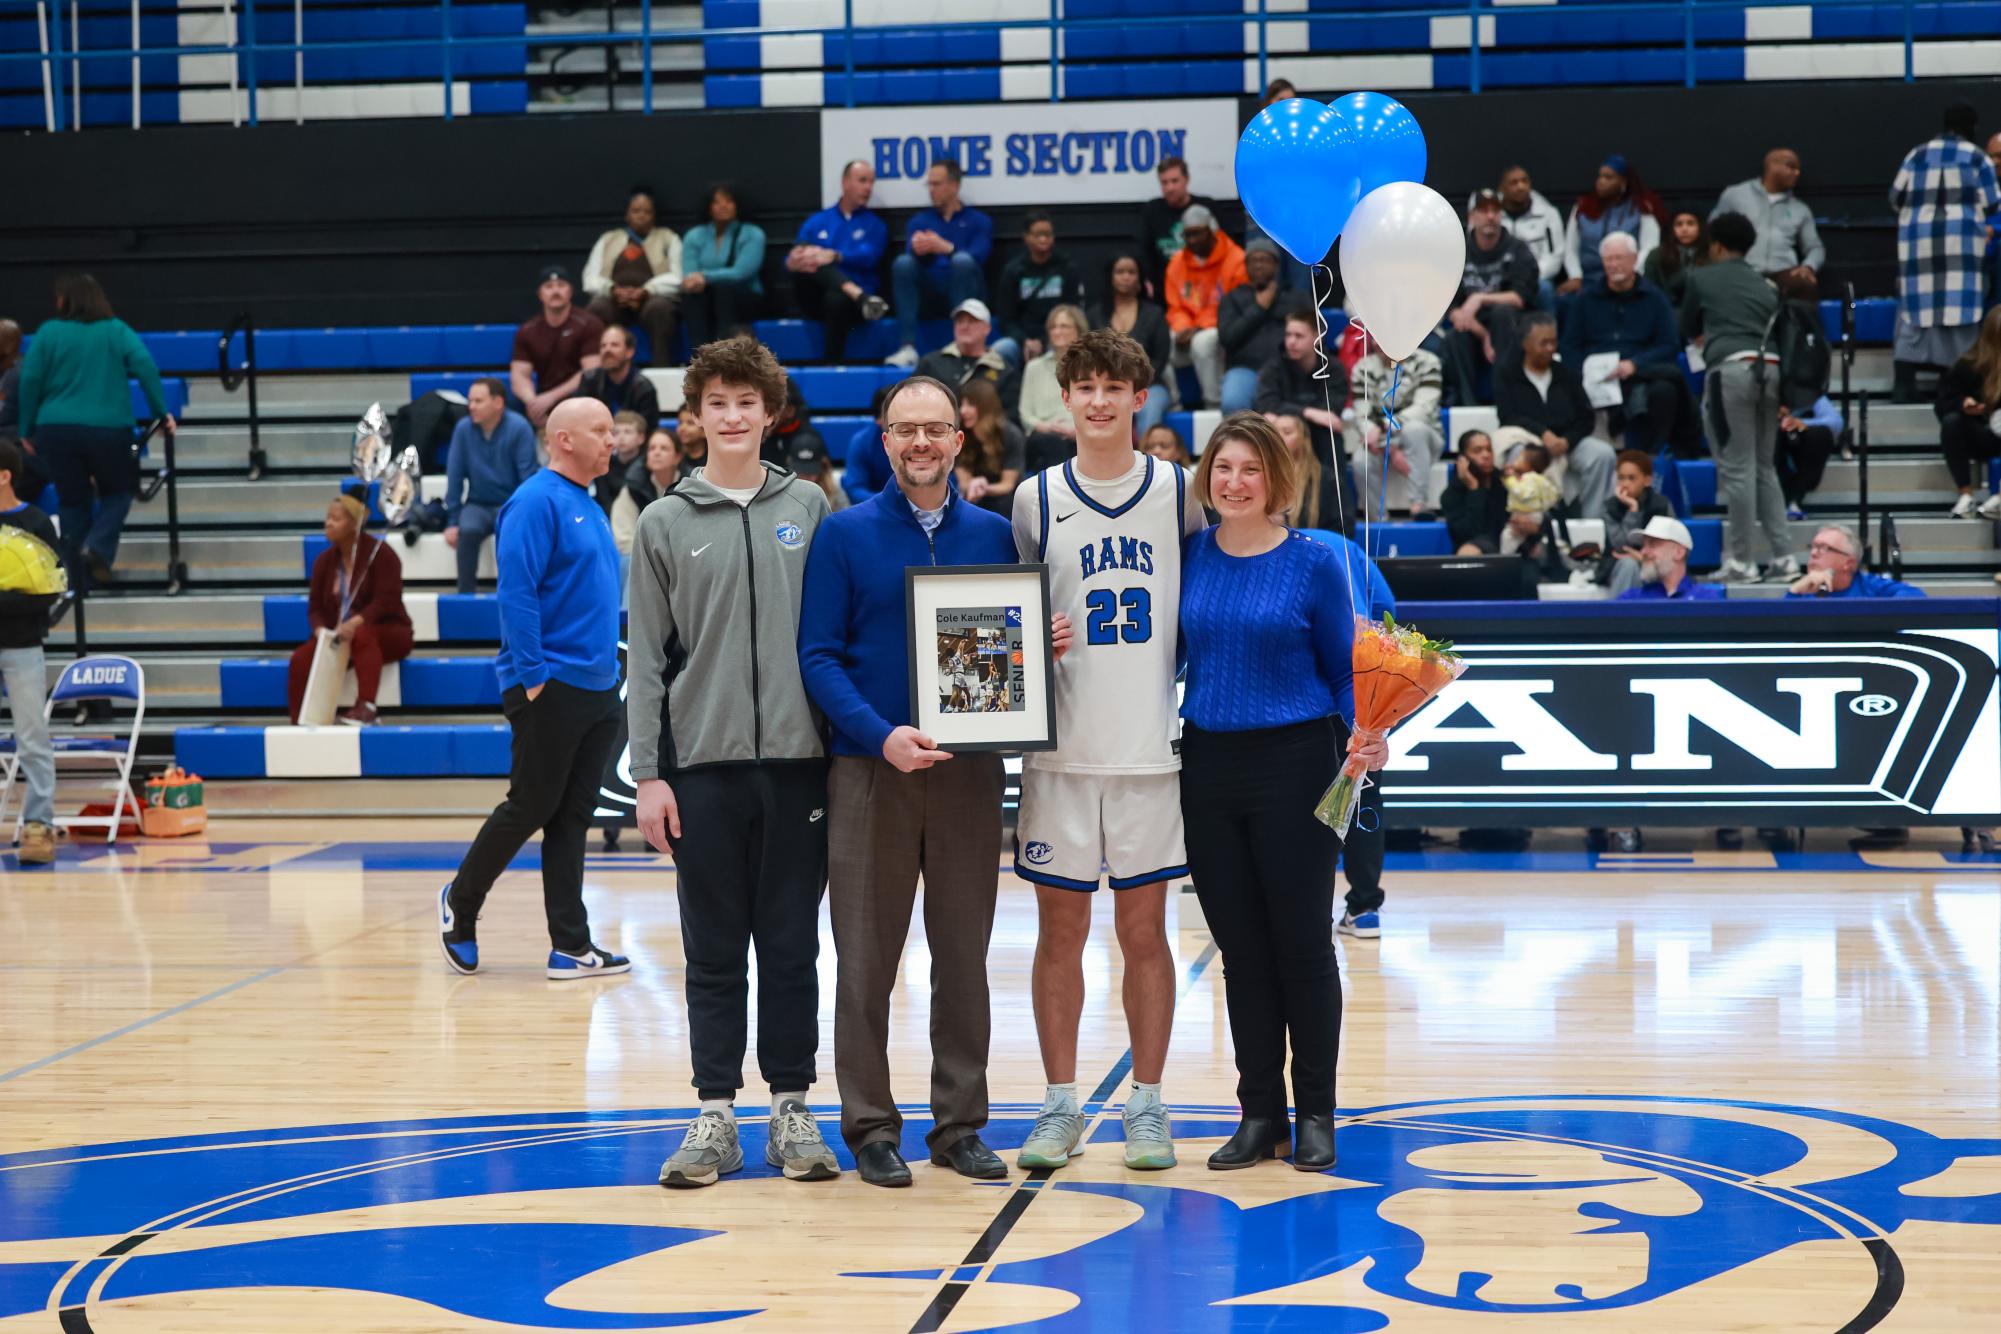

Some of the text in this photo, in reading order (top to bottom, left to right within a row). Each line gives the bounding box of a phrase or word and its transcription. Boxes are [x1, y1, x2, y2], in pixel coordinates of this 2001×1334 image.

[872, 129, 1187, 180] HOME SECTION
[1079, 535, 1154, 581] RAMS
[937, 611, 1005, 623] Cole Kaufman
[1086, 587, 1152, 645] 23
[72, 665, 127, 685] LADUE
